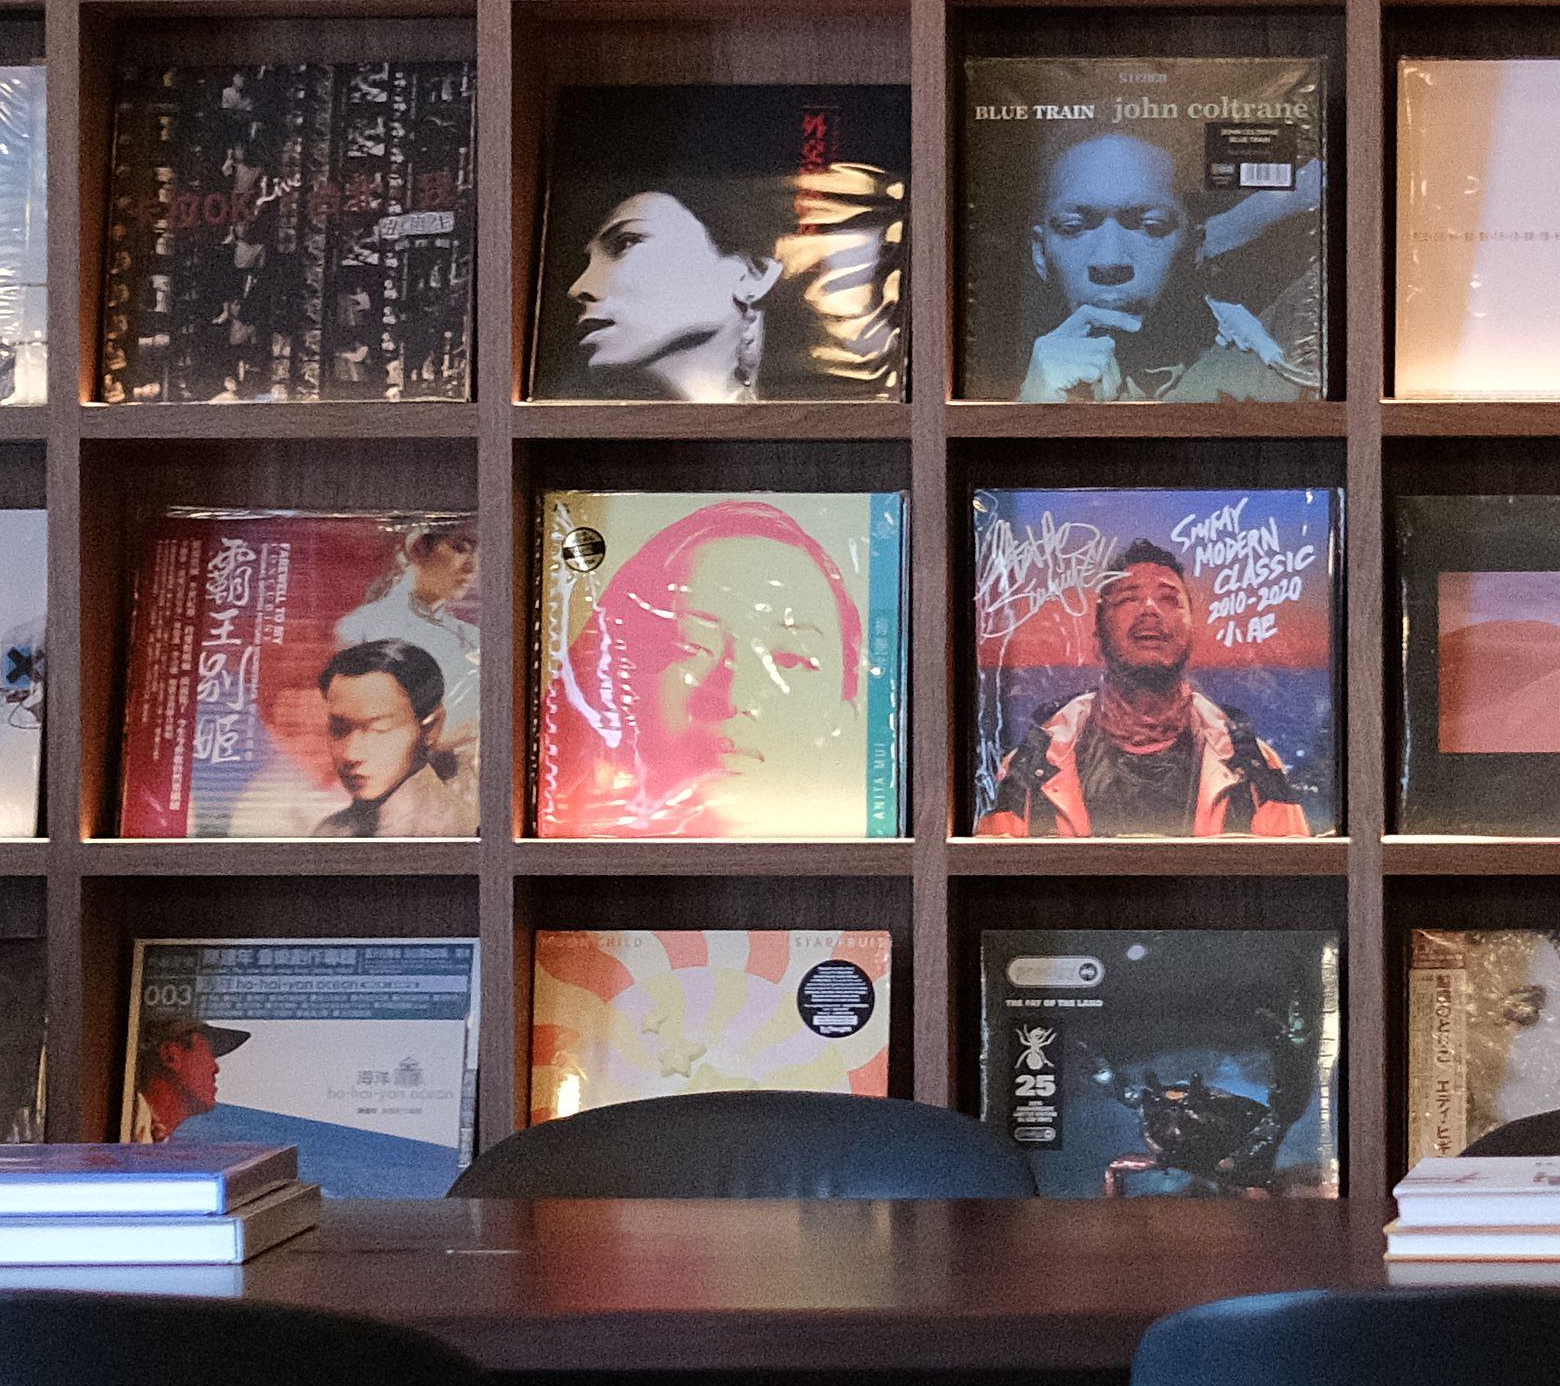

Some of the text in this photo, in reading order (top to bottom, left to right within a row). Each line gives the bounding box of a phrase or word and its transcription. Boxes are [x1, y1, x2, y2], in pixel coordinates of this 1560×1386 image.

[975, 95, 1309, 124] BLUE TRAIN john coltrane
[1193, 516, 1281, 578] MODERN
[1214, 544, 1315, 594] CLASSIC
[276, 543, 291, 603] FAREWELL
[1207, 577, 1304, 625] 2010-2020
[873, 741, 887, 820] ANITA MUI
[143, 984, 193, 1007] 003
[1014, 1074, 1057, 1097] 25
